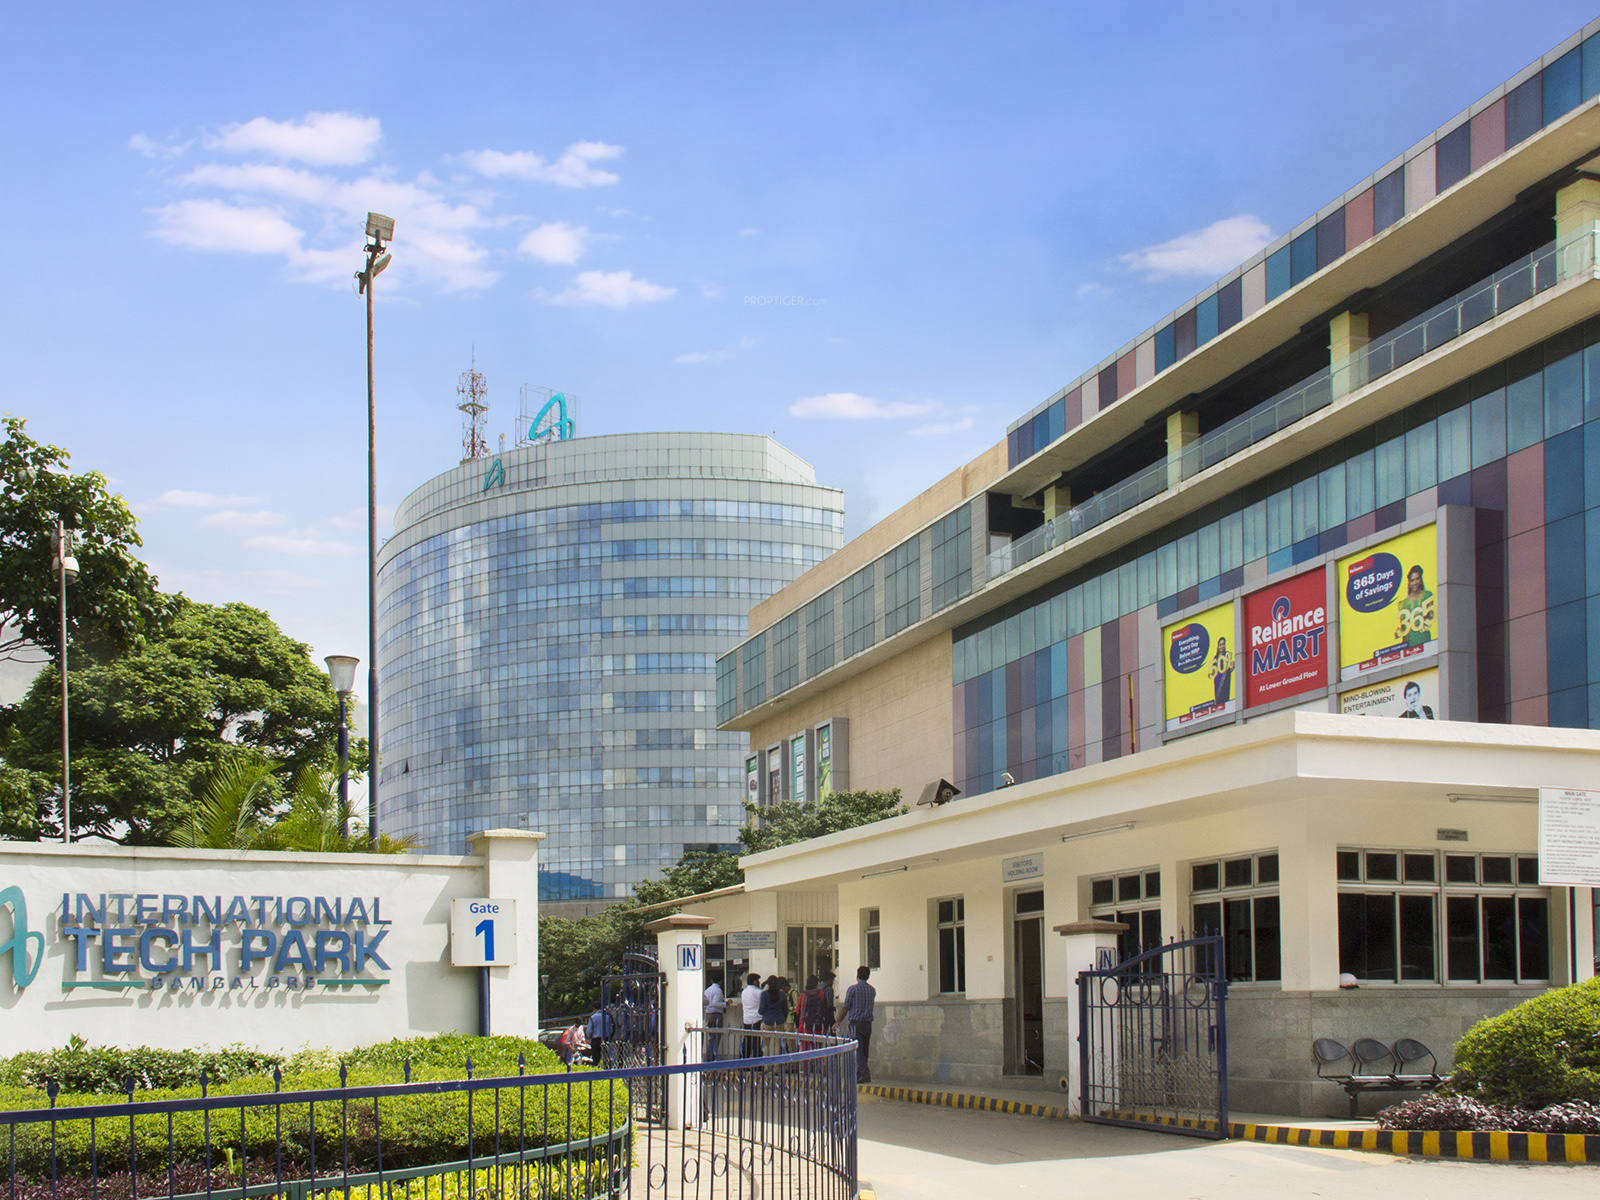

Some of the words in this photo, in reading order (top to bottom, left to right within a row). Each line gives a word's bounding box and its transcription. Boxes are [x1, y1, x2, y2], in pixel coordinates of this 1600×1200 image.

[1353, 573, 1376, 590] 365
[1376, 569, 1395, 582] Days
[1355, 590, 1364, 600] of
[1364, 581, 1393, 598] Savings
[1252, 607, 1324, 647] Reliance
[1397, 596, 1437, 638] 365
[1252, 625, 1325, 676] MART
[1266, 679, 1282, 691] Lower
[1282, 673, 1303, 686] Ground
[1303, 670, 1318, 680] Floor
[1343, 685, 1392, 704] MIND-BLOWING
[1343, 694, 1396, 714] ENTERTAINMENT
[1007, 868, 1025, 876] HOLDING
[1012, 859, 1033, 868] VISITORS
[62, 892, 392, 926] INTERNATIONAL
[469, 902, 500, 914] Gate
[64, 927, 221, 972] TECH
[241, 929, 392, 972] PARK
[475, 919, 495, 961] 1
[682, 947, 696, 967] IN
[1100, 950, 1112, 968] IN
[152, 976, 316, 989] BANGALORE
